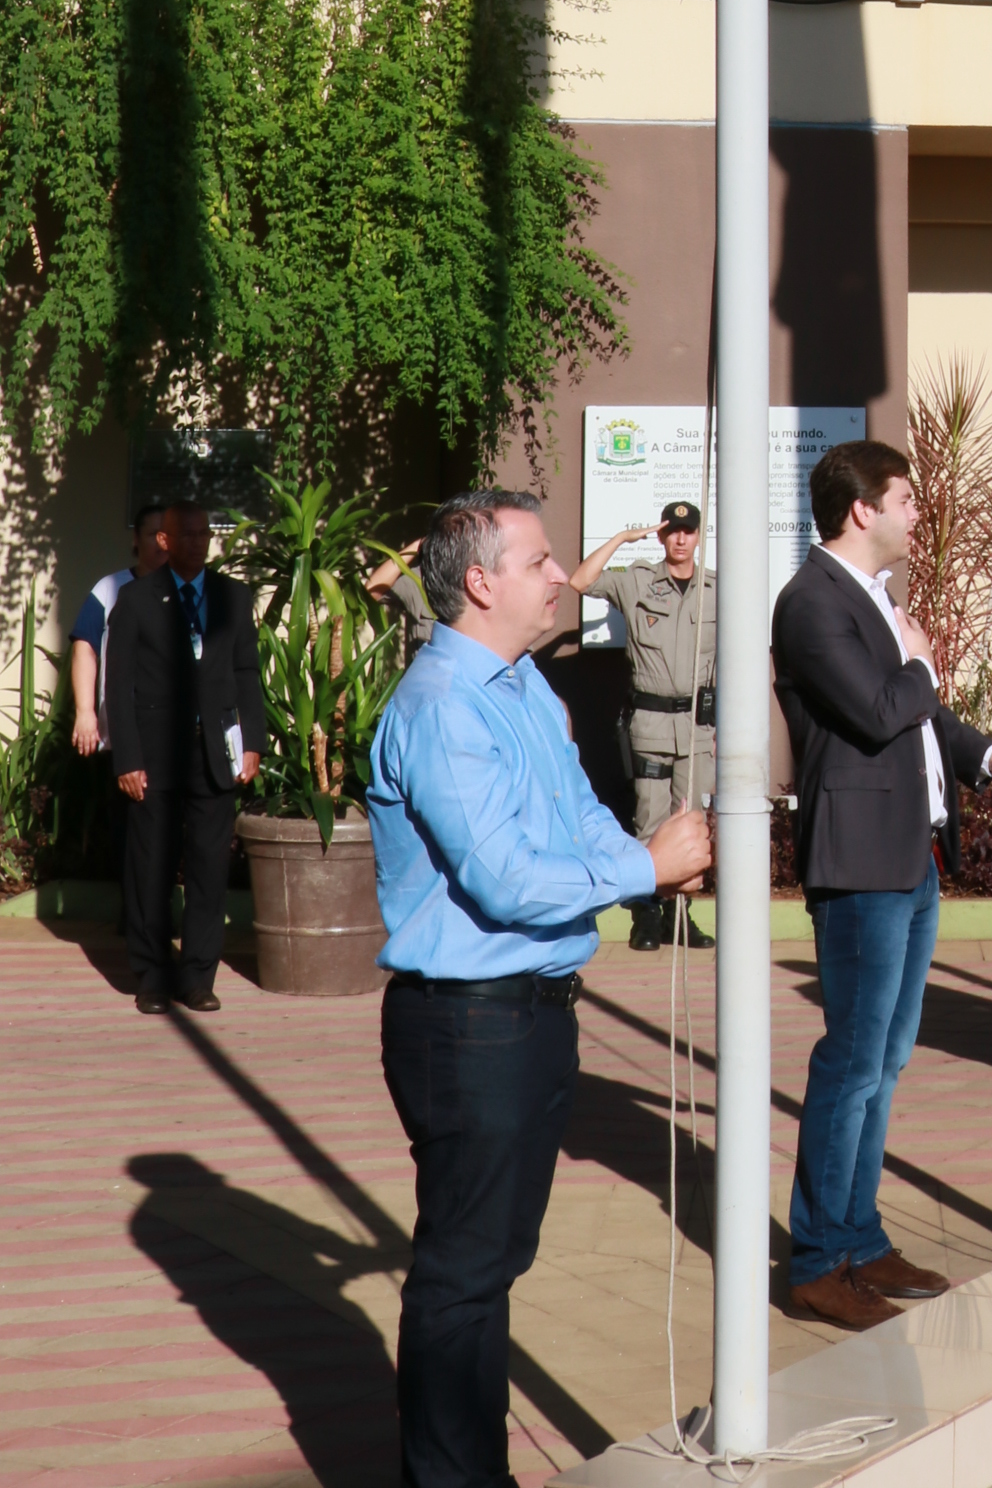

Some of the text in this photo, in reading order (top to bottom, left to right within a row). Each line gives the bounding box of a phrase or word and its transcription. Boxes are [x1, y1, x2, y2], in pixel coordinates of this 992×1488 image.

[676, 427, 699, 439] Sua
[782, 428, 827, 439] mundo.
[650, 442, 660, 453] A
[663, 442, 705, 453] Câmar
[774, 442, 781, 453] é
[785, 444, 792, 453] a
[795, 444, 817, 453] sua
